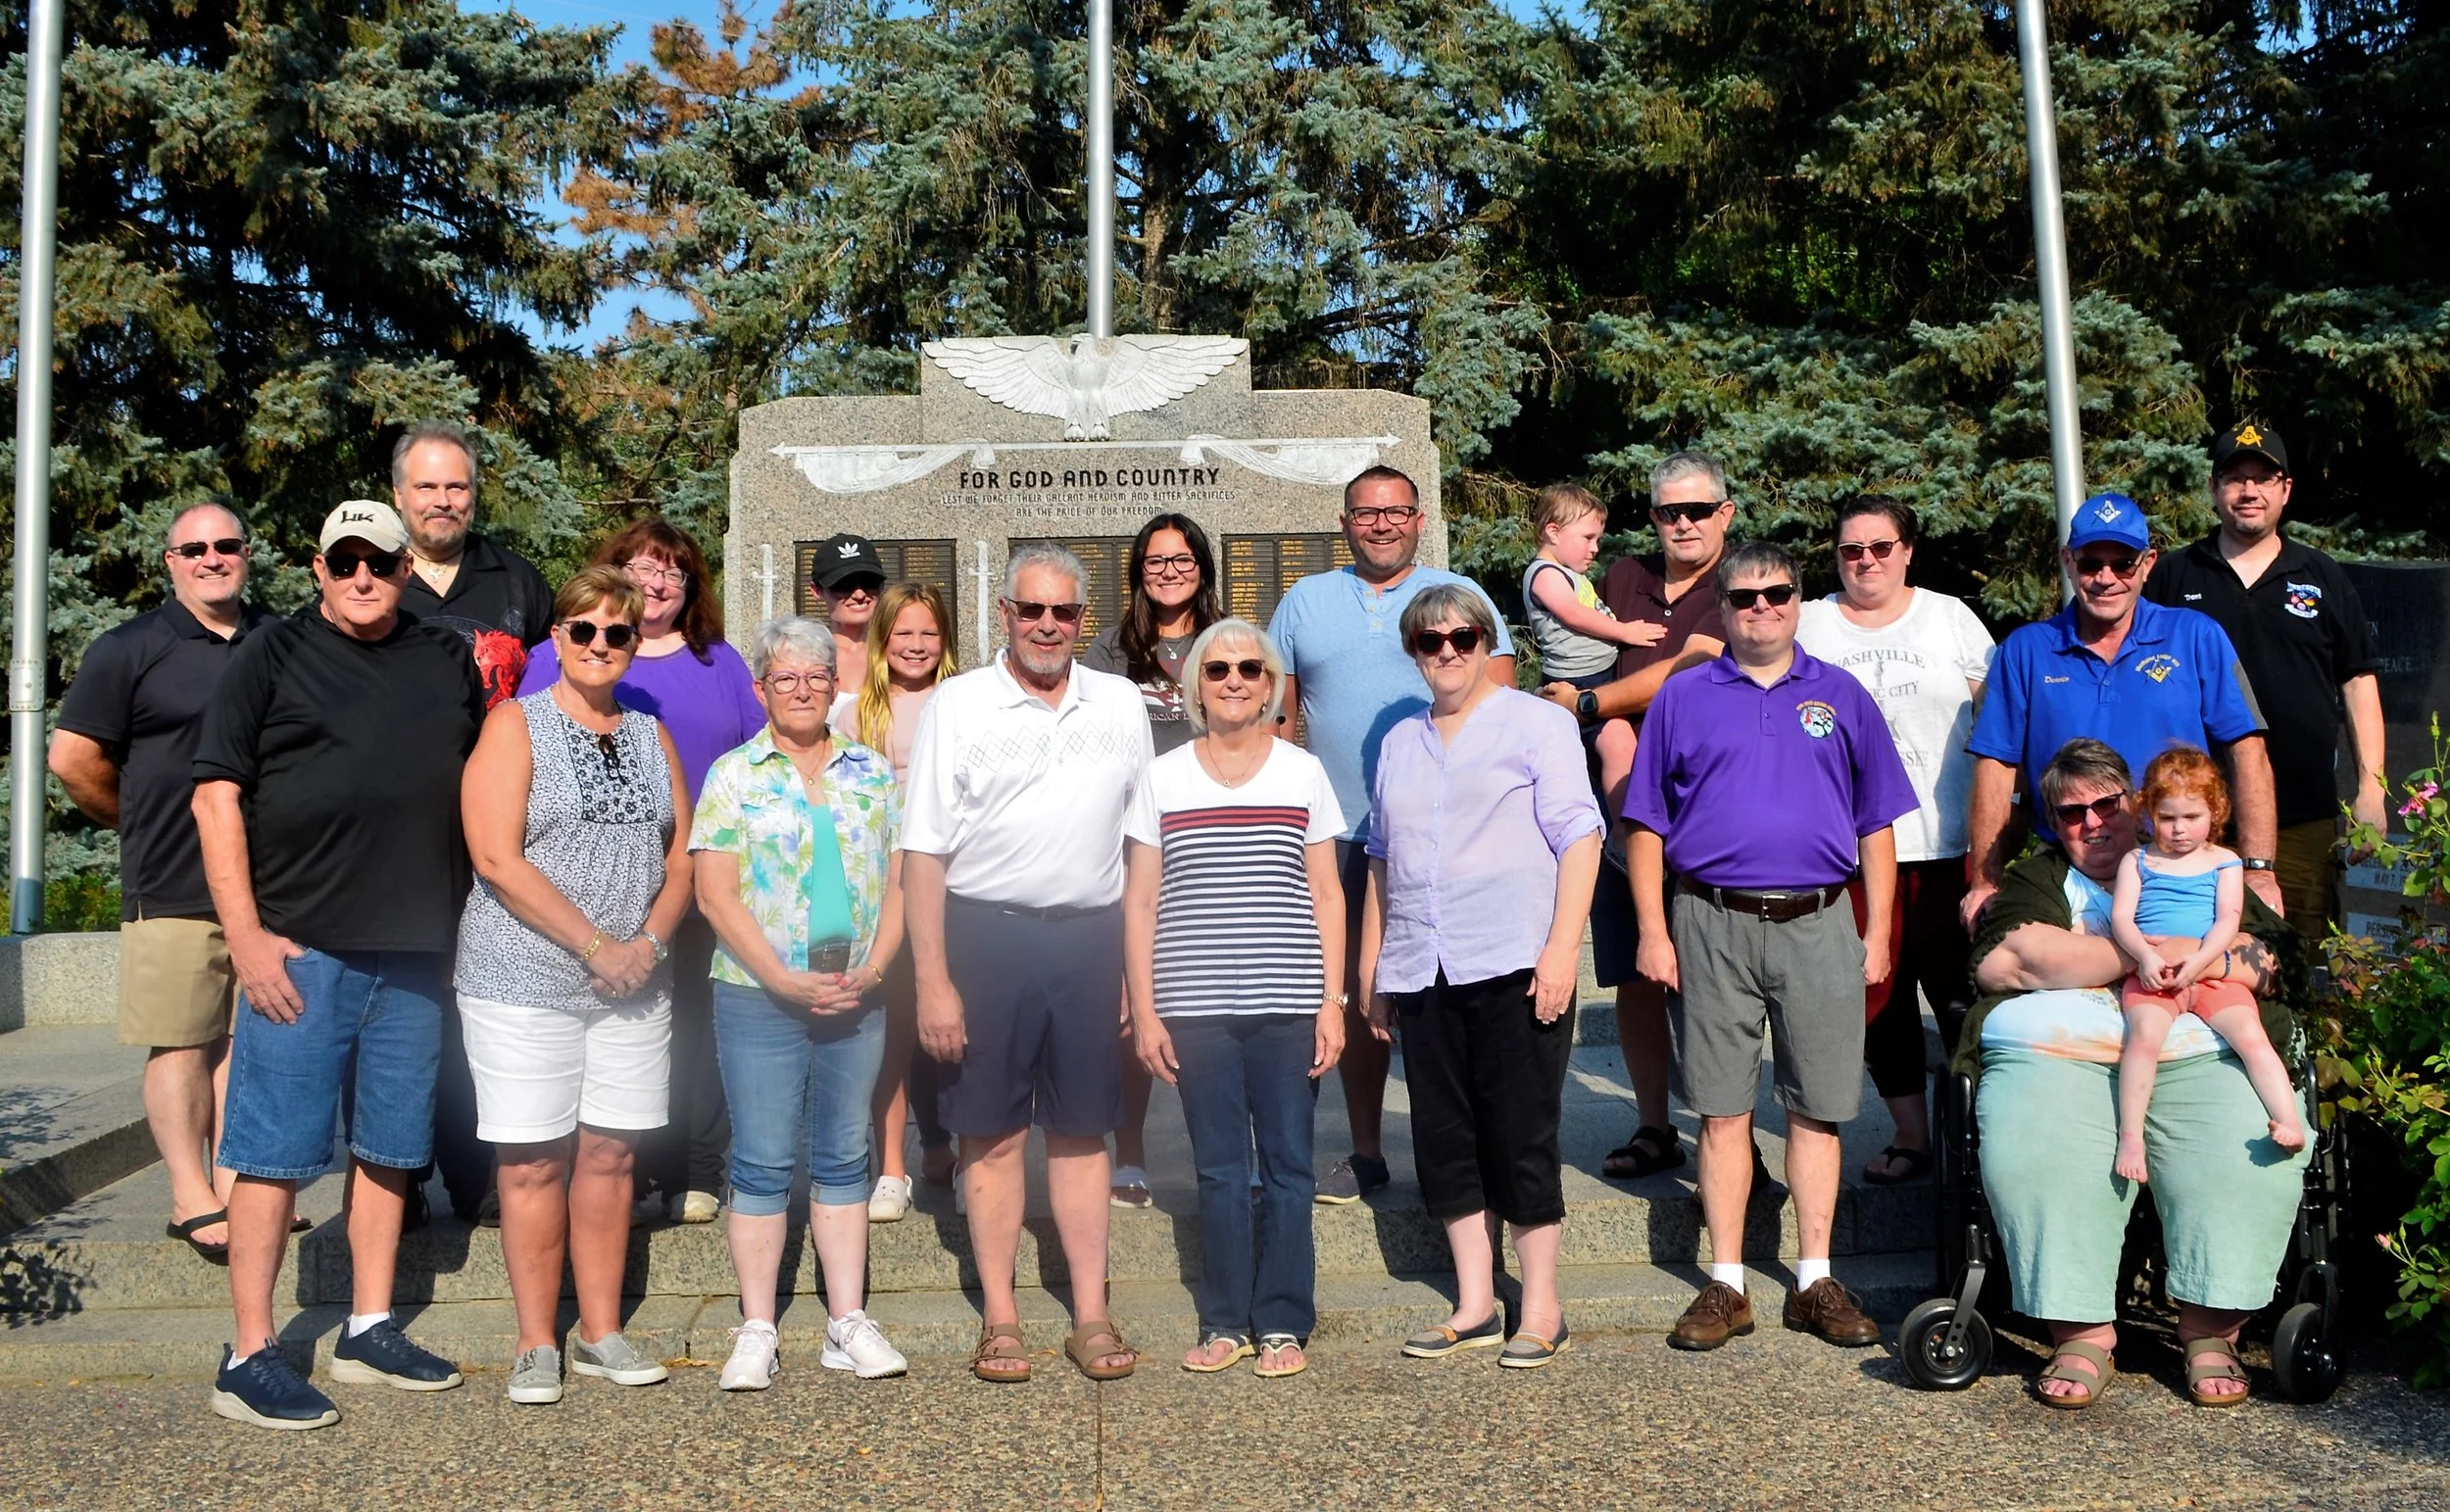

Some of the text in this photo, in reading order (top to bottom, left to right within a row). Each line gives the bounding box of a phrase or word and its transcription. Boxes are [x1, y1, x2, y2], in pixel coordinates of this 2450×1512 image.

[960, 467, 1220, 489] FOR GOD AND COUNTRY
[942, 495, 961, 505] LEST
[1153, 491, 1181, 501] BITTER
[1186, 490, 1235, 500] SACRIFICES
[1016, 508, 1032, 517] ARE
[1037, 508, 1052, 517] THE
[1056, 508, 1080, 516] PRICE
[1086, 507, 1096, 515] OF
[1101, 507, 1117, 515] OUR
[1834, 649, 1926, 668] ASHVILLE
[1889, 680, 1919, 698] CITY
[1150, 712, 1179, 721] RICAN
